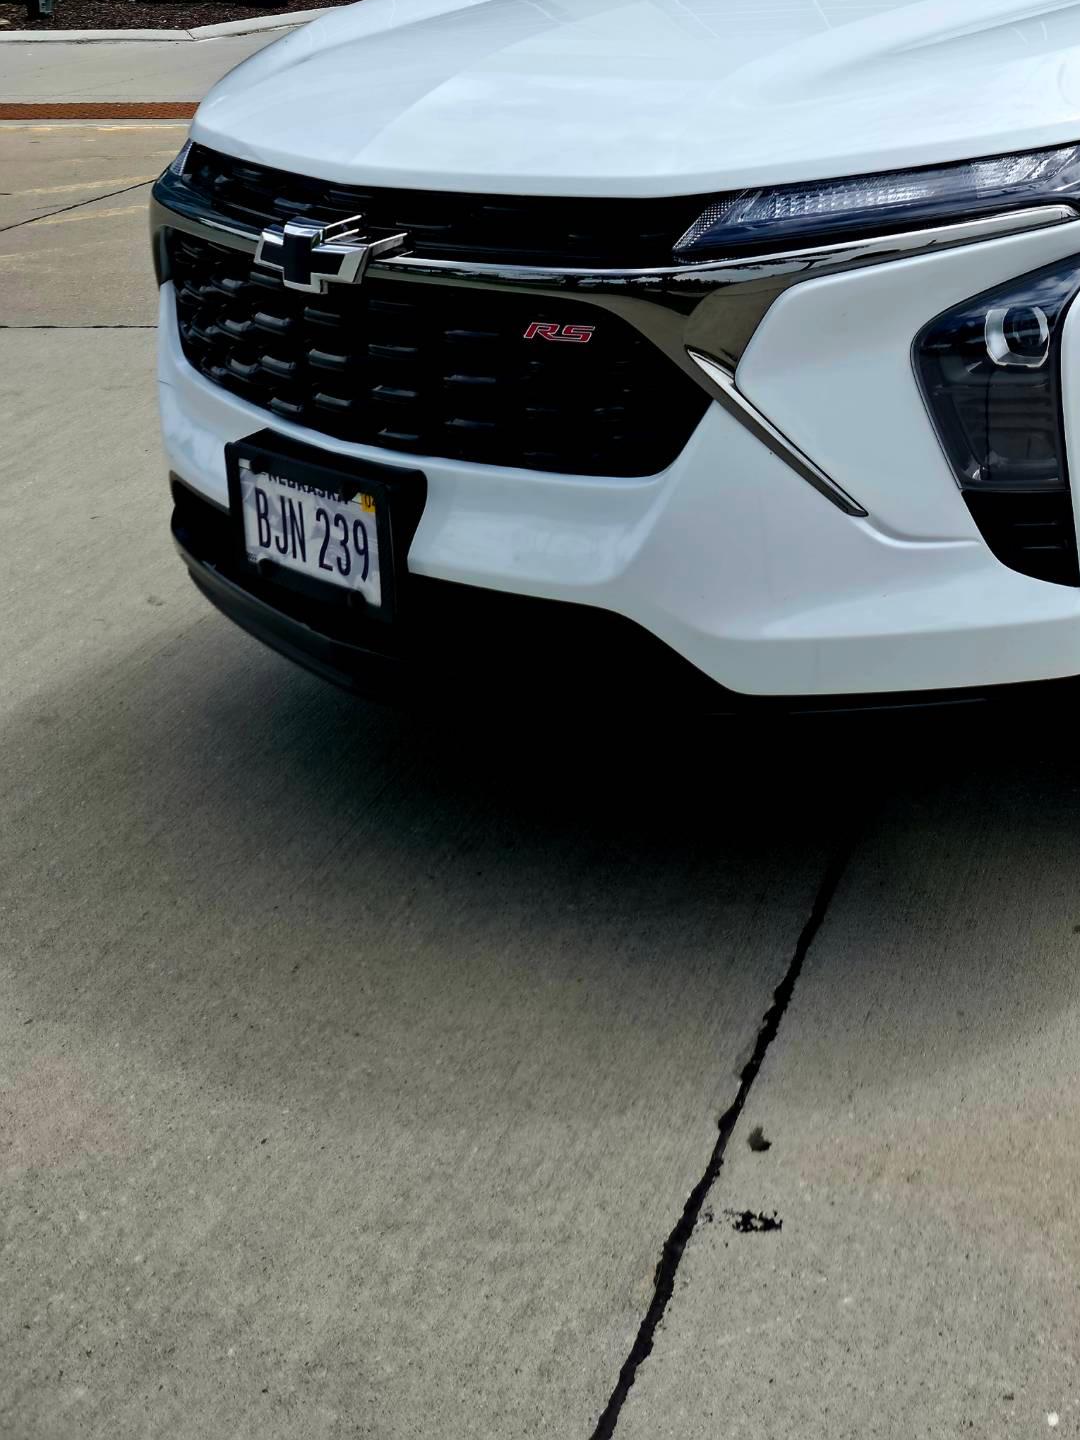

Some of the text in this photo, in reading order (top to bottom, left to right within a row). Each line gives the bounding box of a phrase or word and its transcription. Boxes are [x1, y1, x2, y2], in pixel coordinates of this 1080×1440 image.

[523, 322, 596, 343] RS
[255, 488, 369, 582] BJN 239
